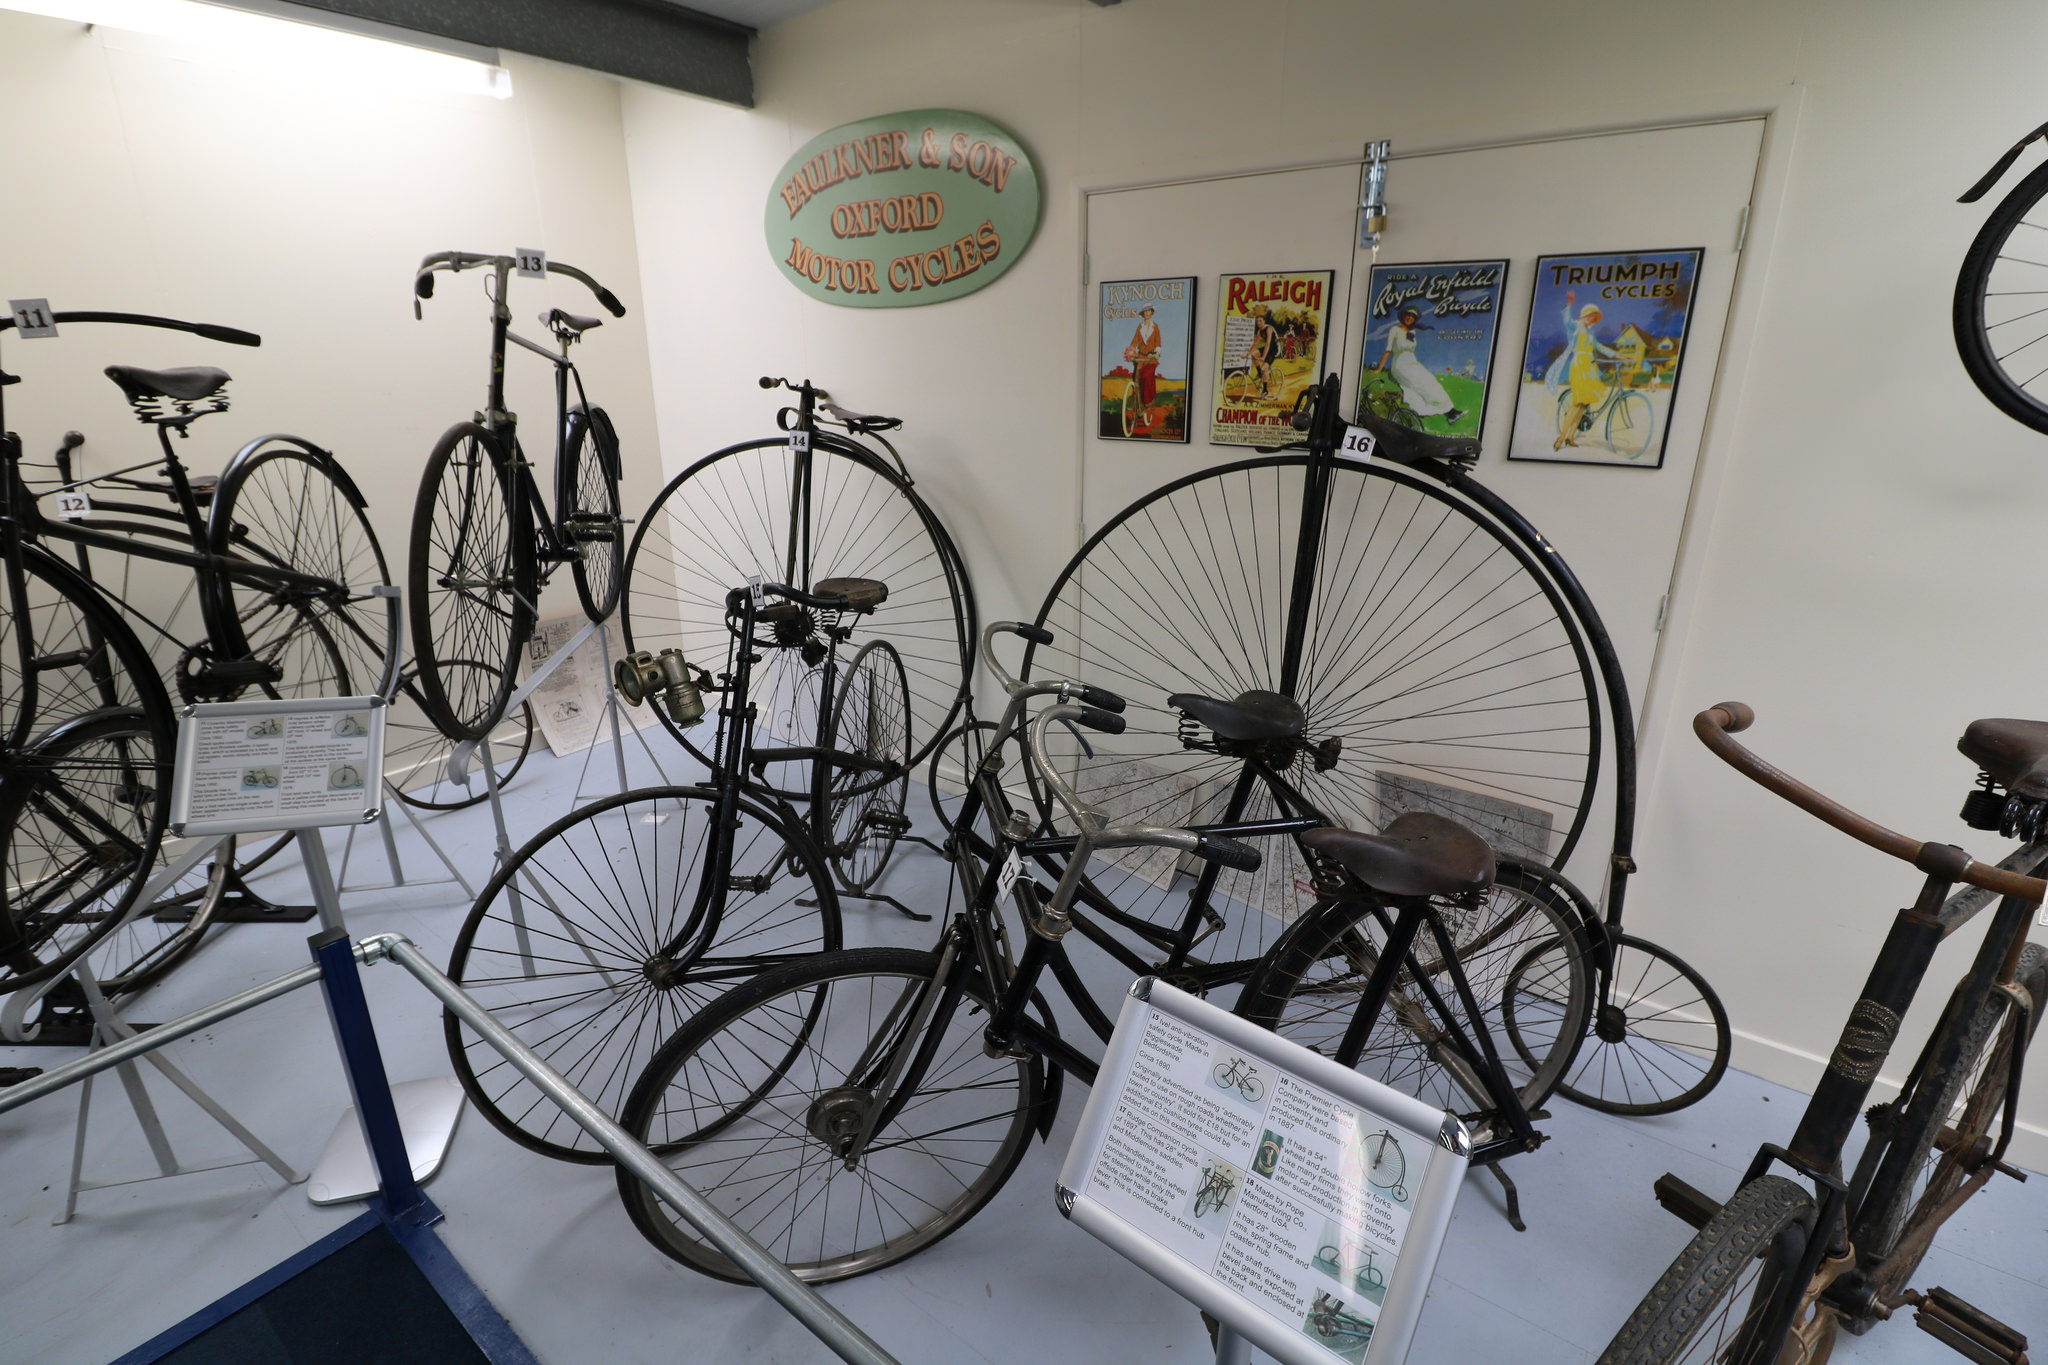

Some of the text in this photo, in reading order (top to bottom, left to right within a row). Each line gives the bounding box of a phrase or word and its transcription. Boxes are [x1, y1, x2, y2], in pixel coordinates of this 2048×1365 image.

[780, 128, 1017, 218] FAULKNER & SON
[832, 192, 944, 238] OXFORD
[521, 256, 542, 271] 13
[786, 220, 1001, 292] MOTOR CYCLES
[1551, 261, 1680, 286] TRIUMPH
[1108, 282, 1184, 305] KYNOCH
[1227, 277, 1322, 314] RALEIGH
[1373, 269, 1498, 317] Royal Enfield
[1433, 296, 1491, 317] Bicycle
[1602, 283, 1678, 300] CYCLES
[17, 309, 49, 328] 11
[1104, 303, 1137, 321] Cycles
[1216, 408, 1259, 425] CHAMPION
[1259, 415, 1267, 424] OF
[1268, 416, 1280, 425] THE
[792, 436, 806, 446] 14
[1347, 435, 1370, 452] 16
[61, 498, 85, 511] 12
[751, 583, 761, 599] 15
[1145, 1030, 1183, 1055] Biggleswade,
[1148, 1023, 1166, 1037] safety
[1184, 1040, 1202, 1054] Made
[1202, 1049, 1209, 1057] in
[1158, 1018, 1171, 1028] Ivel
[1170, 1025, 1208, 1047] anti-vibration
[1138, 1049, 1154, 1062] Circa
[1142, 1037, 1180, 1062] Bedfordshire.
[1134, 1061, 1162, 1081] Originally
[1162, 1077, 1193, 1097] advertised
[1193, 1094, 1201, 1102] as
[1202, 1097, 1220, 1113] being
[1280, 1077, 1289, 1085] 16
[1290, 1081, 1303, 1094] The
[1304, 1089, 1332, 1108] Premier
[1122, 1094, 1142, 1108] added
[1150, 1109, 1158, 1118] on
[1158, 1113, 1170, 1124] this
[1170, 1121, 1197, 1140] example.
[1125, 1086, 1230, 1148] additional £3 cushion tyres could be
[1268, 1112, 1275, 1121] in
[1270, 1105, 1304, 1126] produced
[1304, 1121, 1317, 1133] this
[1274, 1095, 1329, 1127] in Coventry and
[1112, 1123, 1183, 1169] and Middlemore saddles.
[1119, 1105, 1197, 1156] 17 Rudge Companion cycle
[1123, 1118, 1138, 1132] 1897.
[1140, 1127, 1152, 1140] This
[1152, 1135, 1164, 1147] has
[1176, 1150, 1198, 1167] wheels
[1286, 1137, 1292, 1145] It
[1292, 1140, 1306, 1152] has
[1105, 1143, 1187, 1196] connected to the front wheel
[1108, 1134, 1166, 1173] Both handlebars are
[1093, 1175, 1110, 1191] brake.
[1099, 1160, 1118, 1175] offside
[1118, 1172, 1133, 1184] rider
[1132, 1179, 1144, 1191] has
[1150, 1190, 1168, 1206] brake
[1102, 1150, 1175, 1200] for steering while only the
[1096, 1167, 1111, 1181] lever.
[1113, 1176, 1125, 1190] This
[1125, 1185, 1131, 1194] is
[1131, 1190, 1164, 1214] connected
[1163, 1209, 1170, 1218] to
[1176, 1217, 1192, 1232] front
[1192, 1227, 1205, 1239] hub
[1243, 1188, 1292, 1222] Manufacturing
[1246, 1177, 1304, 1217] 18 Made by Pope
[1229, 1229, 1270, 1258] coaster hub.
[1232, 1220, 1309, 1270] rims, spring frame and
[1235, 1210, 1241, 1218] It
[1241, 1213, 1255, 1226] has
[1269, 1230, 1296, 1251] wooden
[1215, 1269, 1244, 1292] the front.
[1221, 1250, 1304, 1306] bevel gears, exposed at
[1225, 1241, 1296, 1290] It has shaft drive with
[1218, 1259, 1304, 1318] the back and enclosed at
